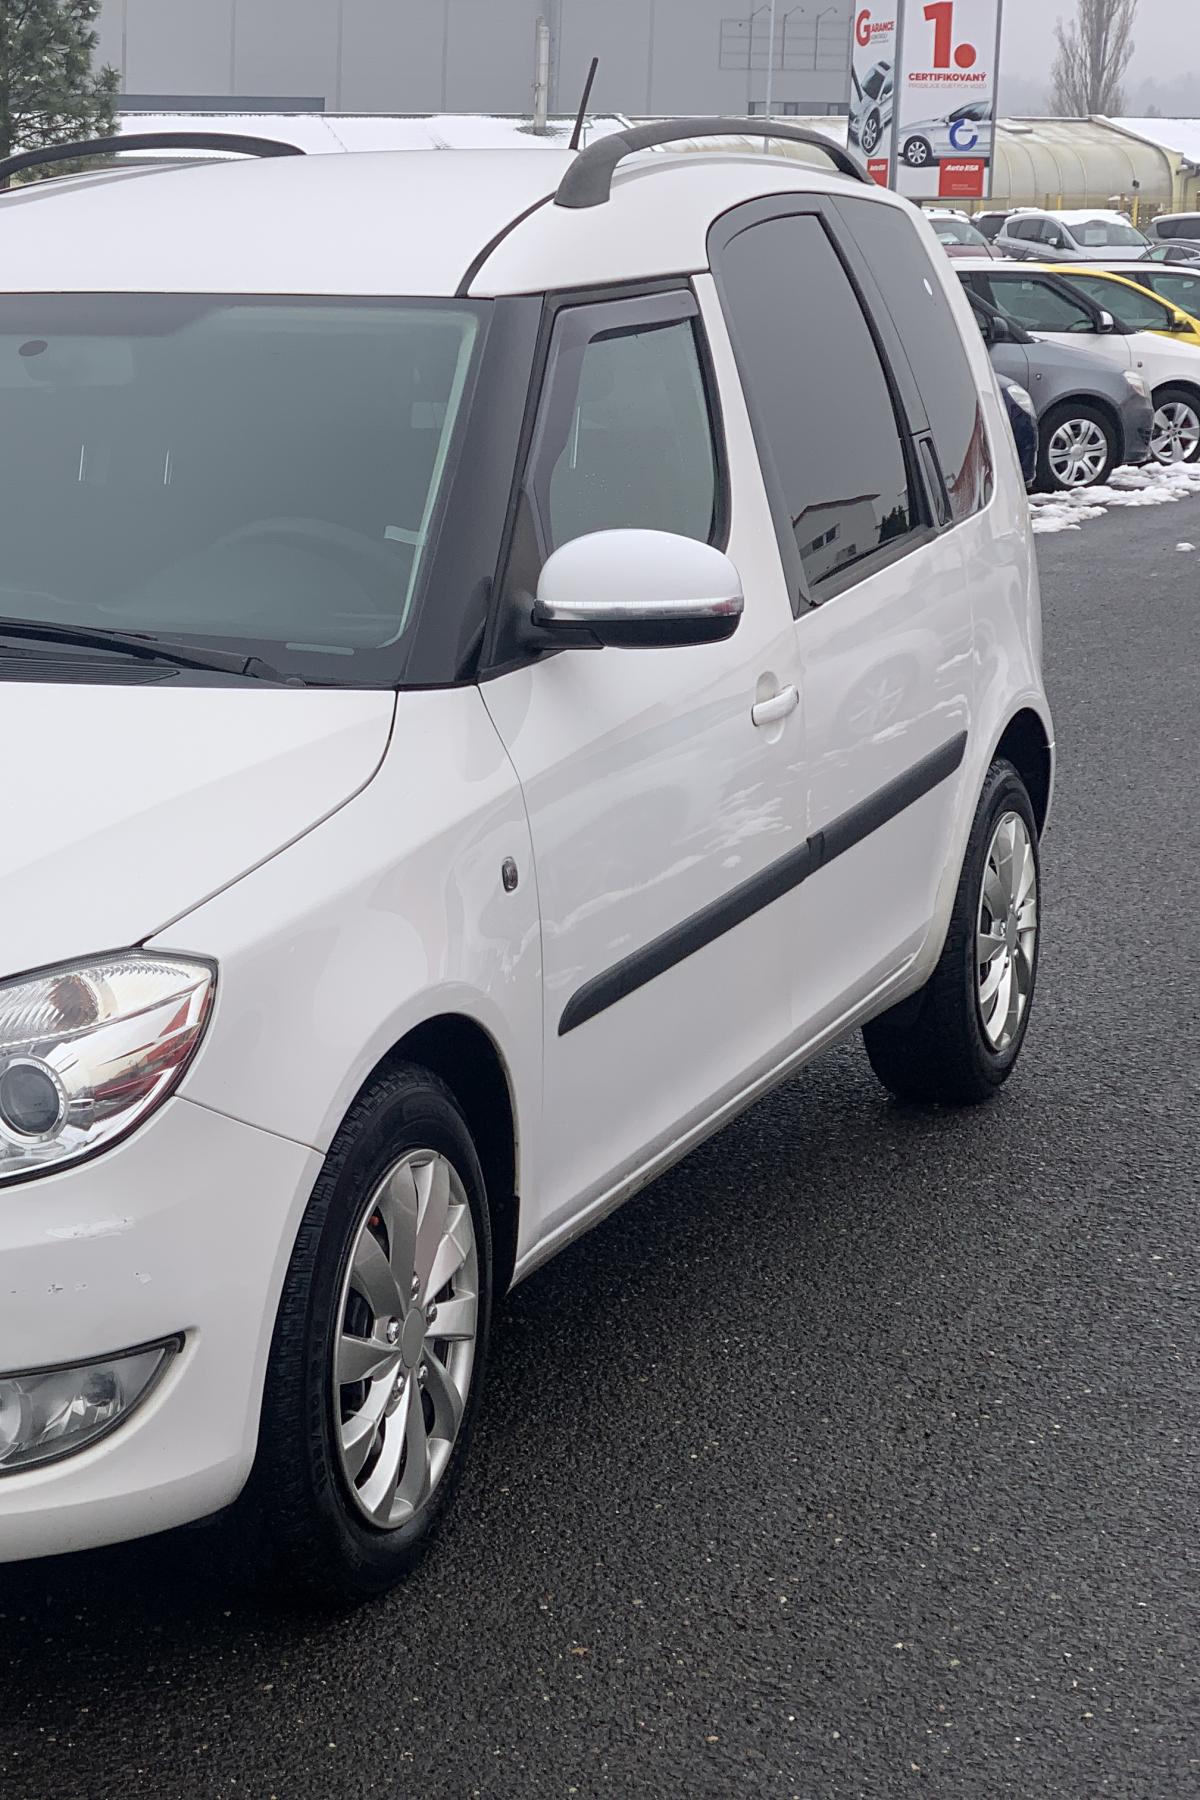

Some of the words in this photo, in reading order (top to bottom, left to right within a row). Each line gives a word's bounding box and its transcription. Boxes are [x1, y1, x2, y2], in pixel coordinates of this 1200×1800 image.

[856, 9, 895, 47] GARANCE
[923, 1, 977, 69] 1.
[908, 72, 987, 82] CERTIFIKOVANÝ
